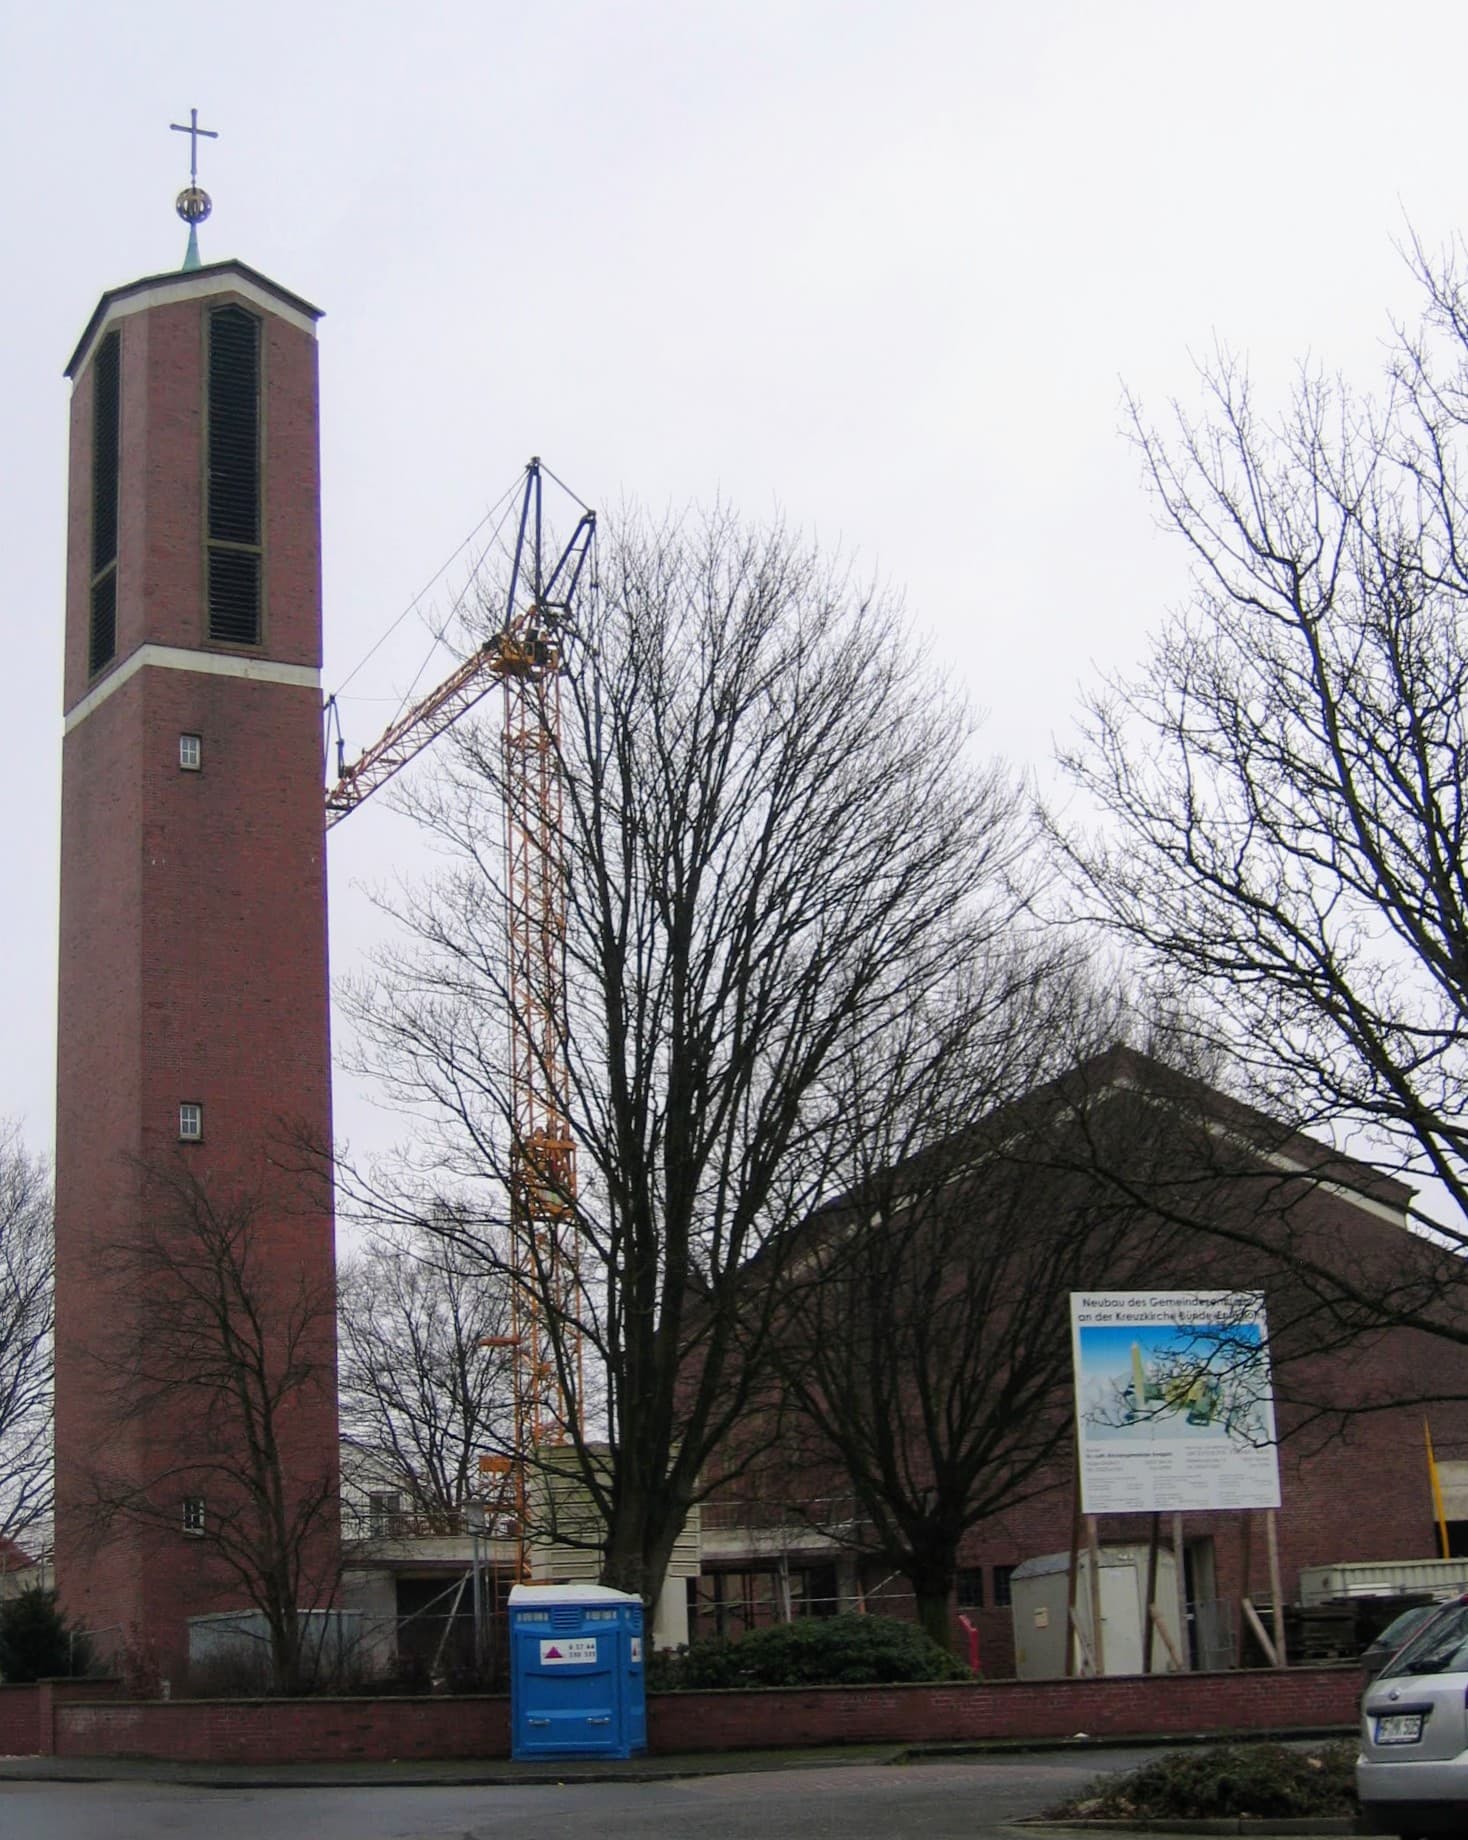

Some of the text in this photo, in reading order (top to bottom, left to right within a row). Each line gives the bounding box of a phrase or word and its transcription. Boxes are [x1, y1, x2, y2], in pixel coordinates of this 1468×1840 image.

[1082, 1297, 1251, 1307] Neubau des Gemeindezen
[1095, 1312, 1112, 1321] der
[1115, 1312, 1176, 1321] Kreuzkirche
